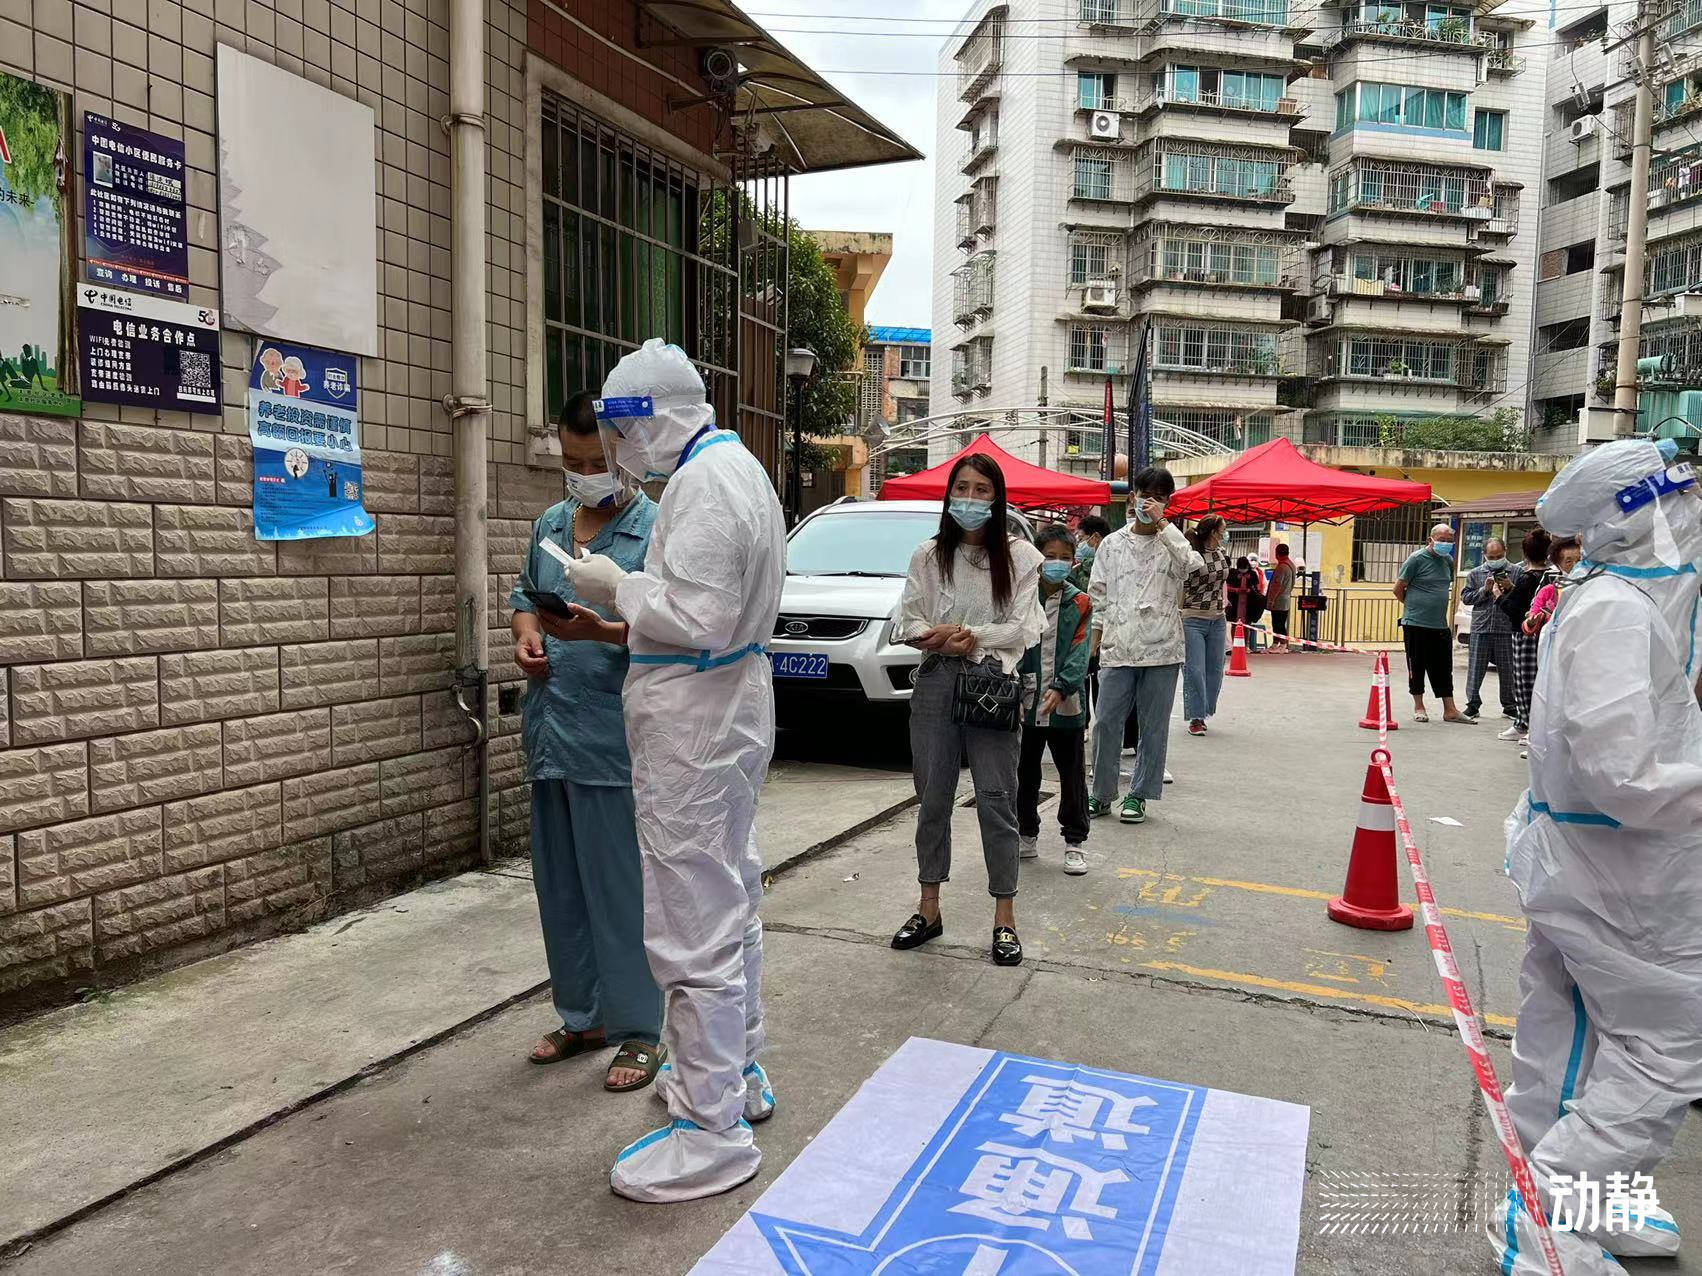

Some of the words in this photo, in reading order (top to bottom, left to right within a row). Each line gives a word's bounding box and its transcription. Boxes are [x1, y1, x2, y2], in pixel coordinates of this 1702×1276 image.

[92, 135, 182, 170] 中国电信小区便民服务卡
[101, 293, 132, 307] 中国电信
[113, 320, 196, 347] 电信业务合作点
[198, 310, 215, 326] 5G
[258, 400, 351, 434] 养老投资需谨慎
[257, 420, 353, 452] 高额回报要小心
[946, 1074, 1158, 1240] 通道
